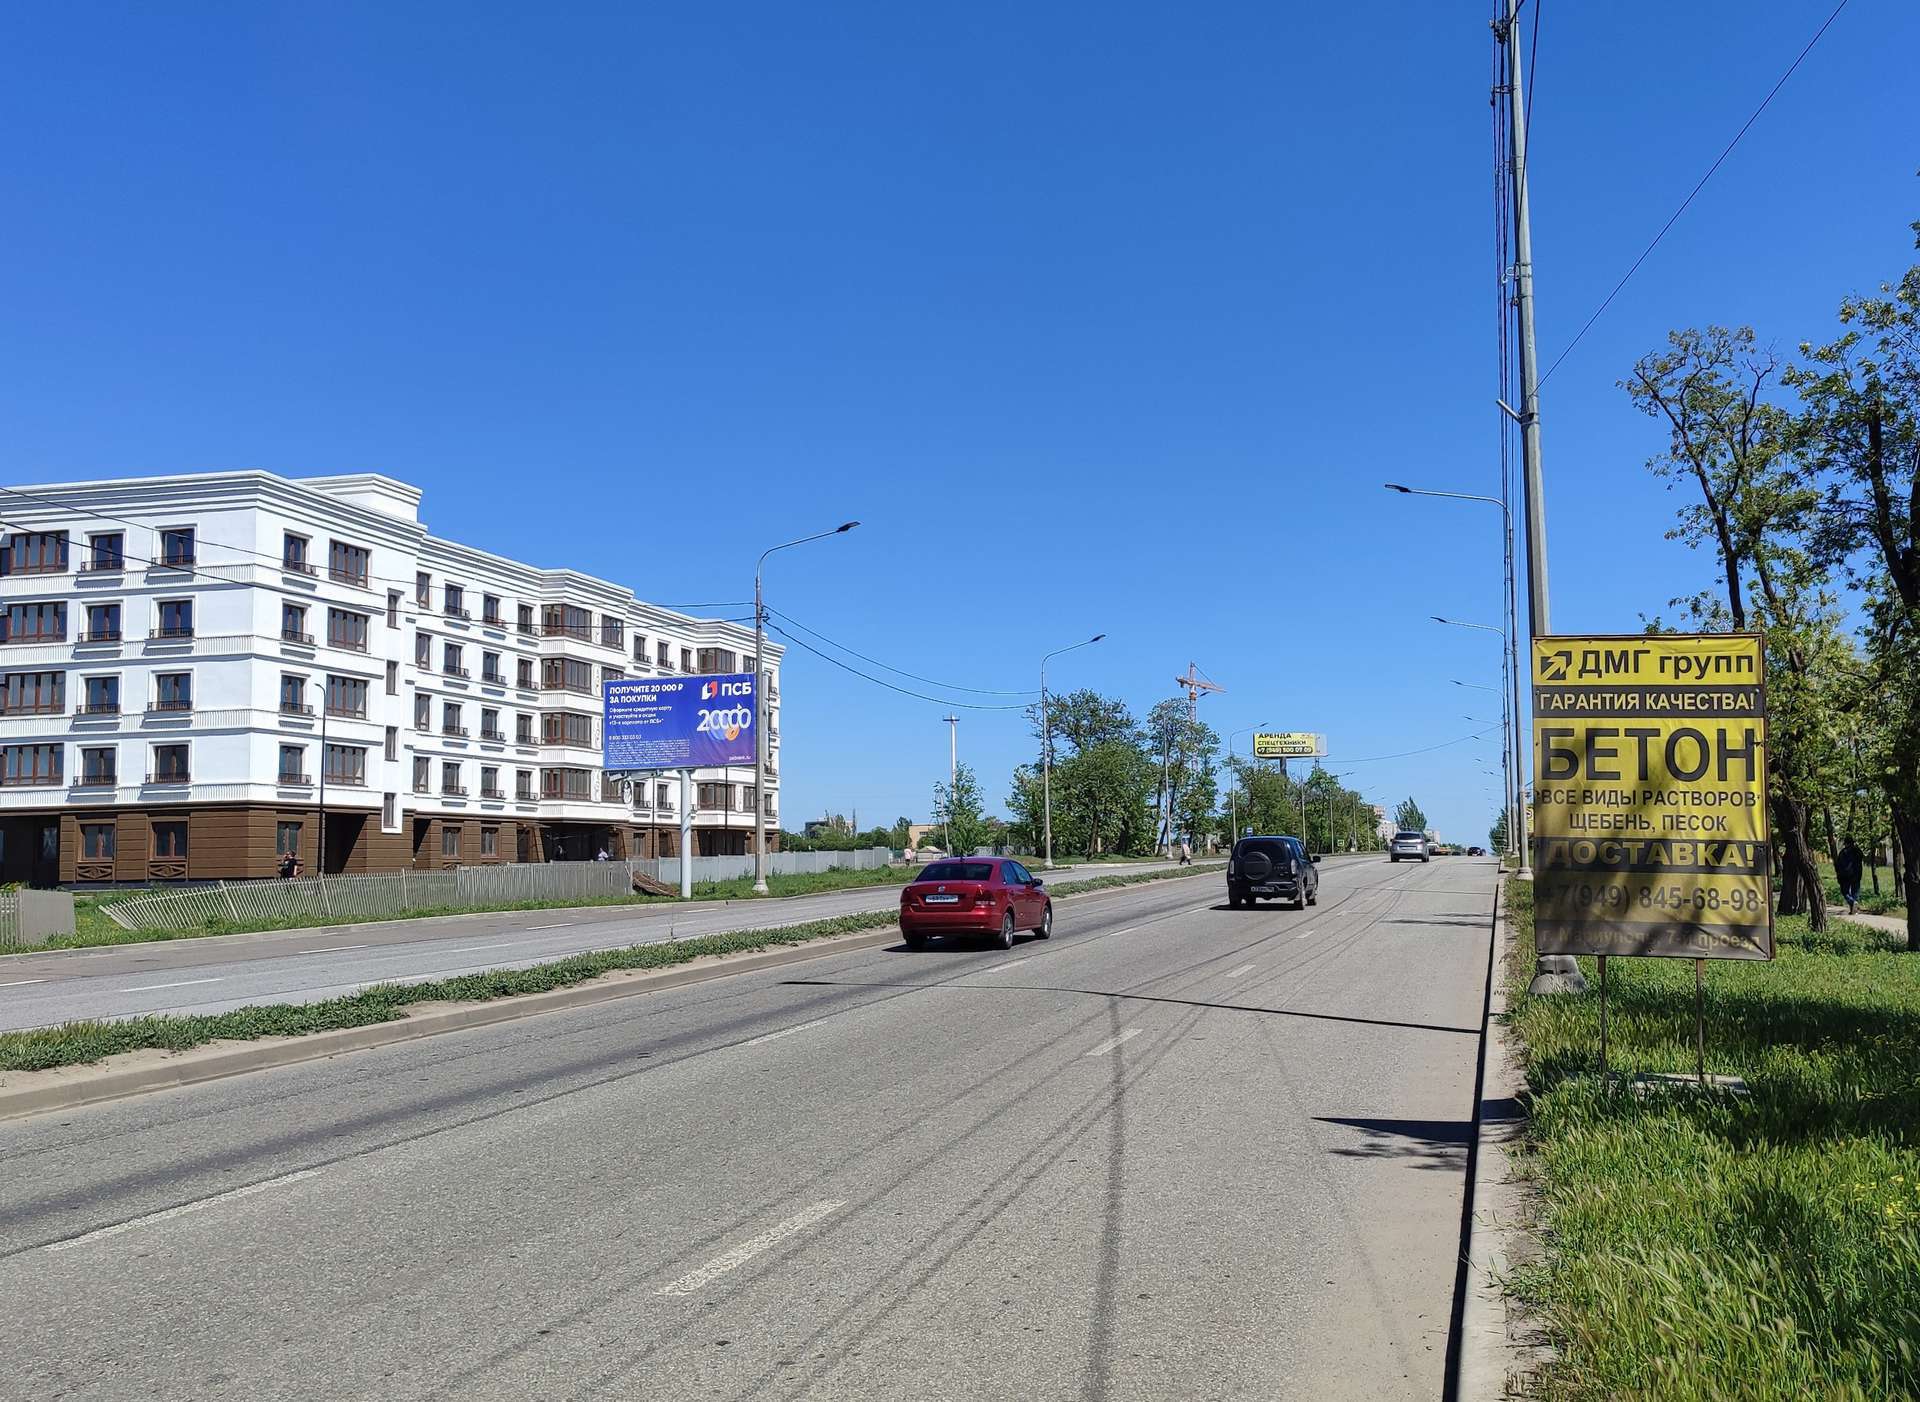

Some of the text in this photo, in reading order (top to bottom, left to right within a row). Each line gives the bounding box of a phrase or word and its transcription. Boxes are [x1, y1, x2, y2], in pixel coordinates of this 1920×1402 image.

[1578, 650, 1754, 680] ДМГ групп
[609, 685, 650, 694] ПОЛУЧИТЕ
[651, 684, 660, 692] 20
[661, 684, 677, 692] 000
[609, 694, 657, 704] ЗА ПОКУПКИ
[721, 682, 752, 696] ПСБ
[1539, 692, 1755, 710] ГАРАНТИЯ КАЧЕСТВА!
[1540, 727, 1756, 782] БЕТОН
[1541, 788, 1757, 808] ВСЕ ВИДЫ РАСТВОРОВ
[1569, 813, 1728, 833] ЩЕБЕНЬ, ПЕСОК
[1544, 840, 1755, 868] ДОСТАВКА!
[1639, 886, 1759, 912] 845-68-98
[1697, 933, 1760, 951] проезд
